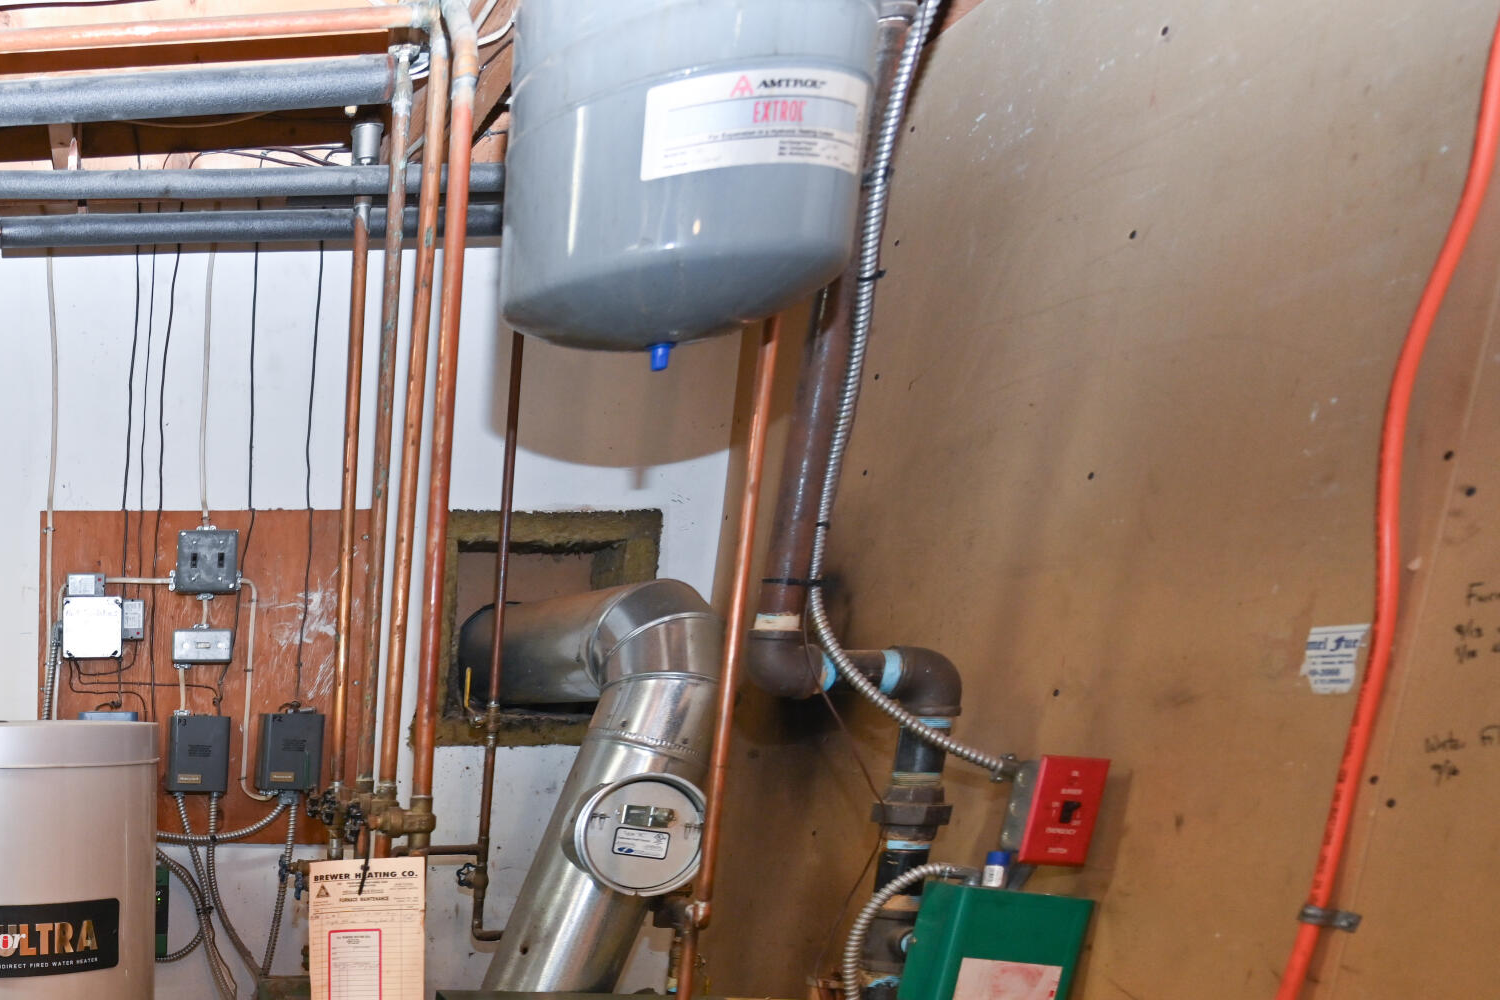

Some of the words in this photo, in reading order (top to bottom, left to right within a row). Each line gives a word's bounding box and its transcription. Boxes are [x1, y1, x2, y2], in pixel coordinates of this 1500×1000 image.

[757, 78, 822, 90] AMTROL
[753, 100, 807, 123] EXTROL
[313, 873, 350, 882] BREWER
